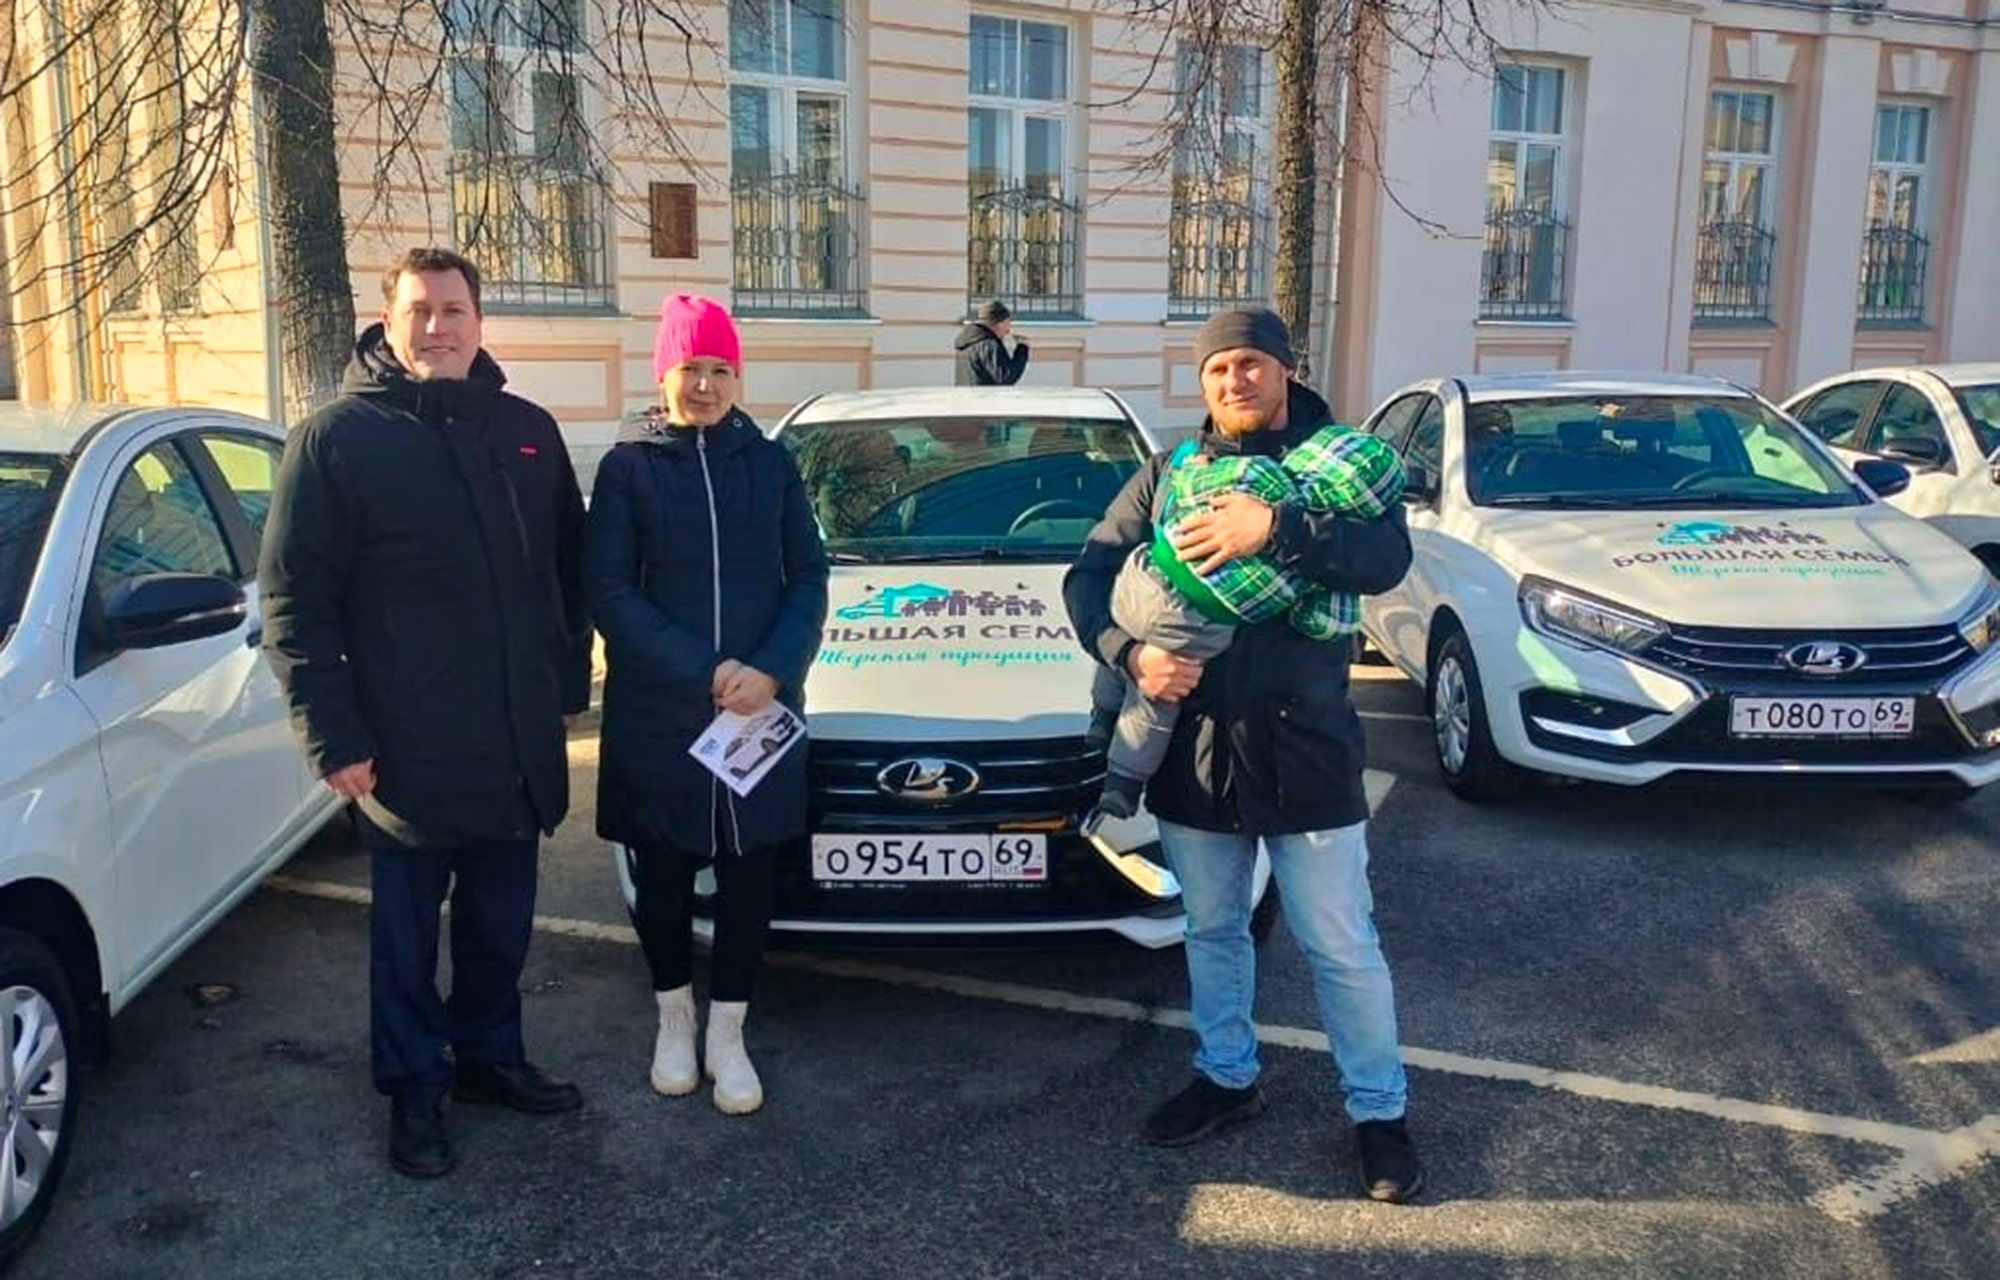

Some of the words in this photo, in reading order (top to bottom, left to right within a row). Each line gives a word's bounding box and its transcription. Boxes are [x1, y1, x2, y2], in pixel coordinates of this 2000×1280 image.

[1612, 549, 1783, 568] БОЛЬШАЯ
[1792, 549, 1910, 567] СЕМЬЯ
[979, 624, 1074, 640] СЕМ
[1874, 701, 1904, 721] 69
[995, 838, 1033, 866] 69
